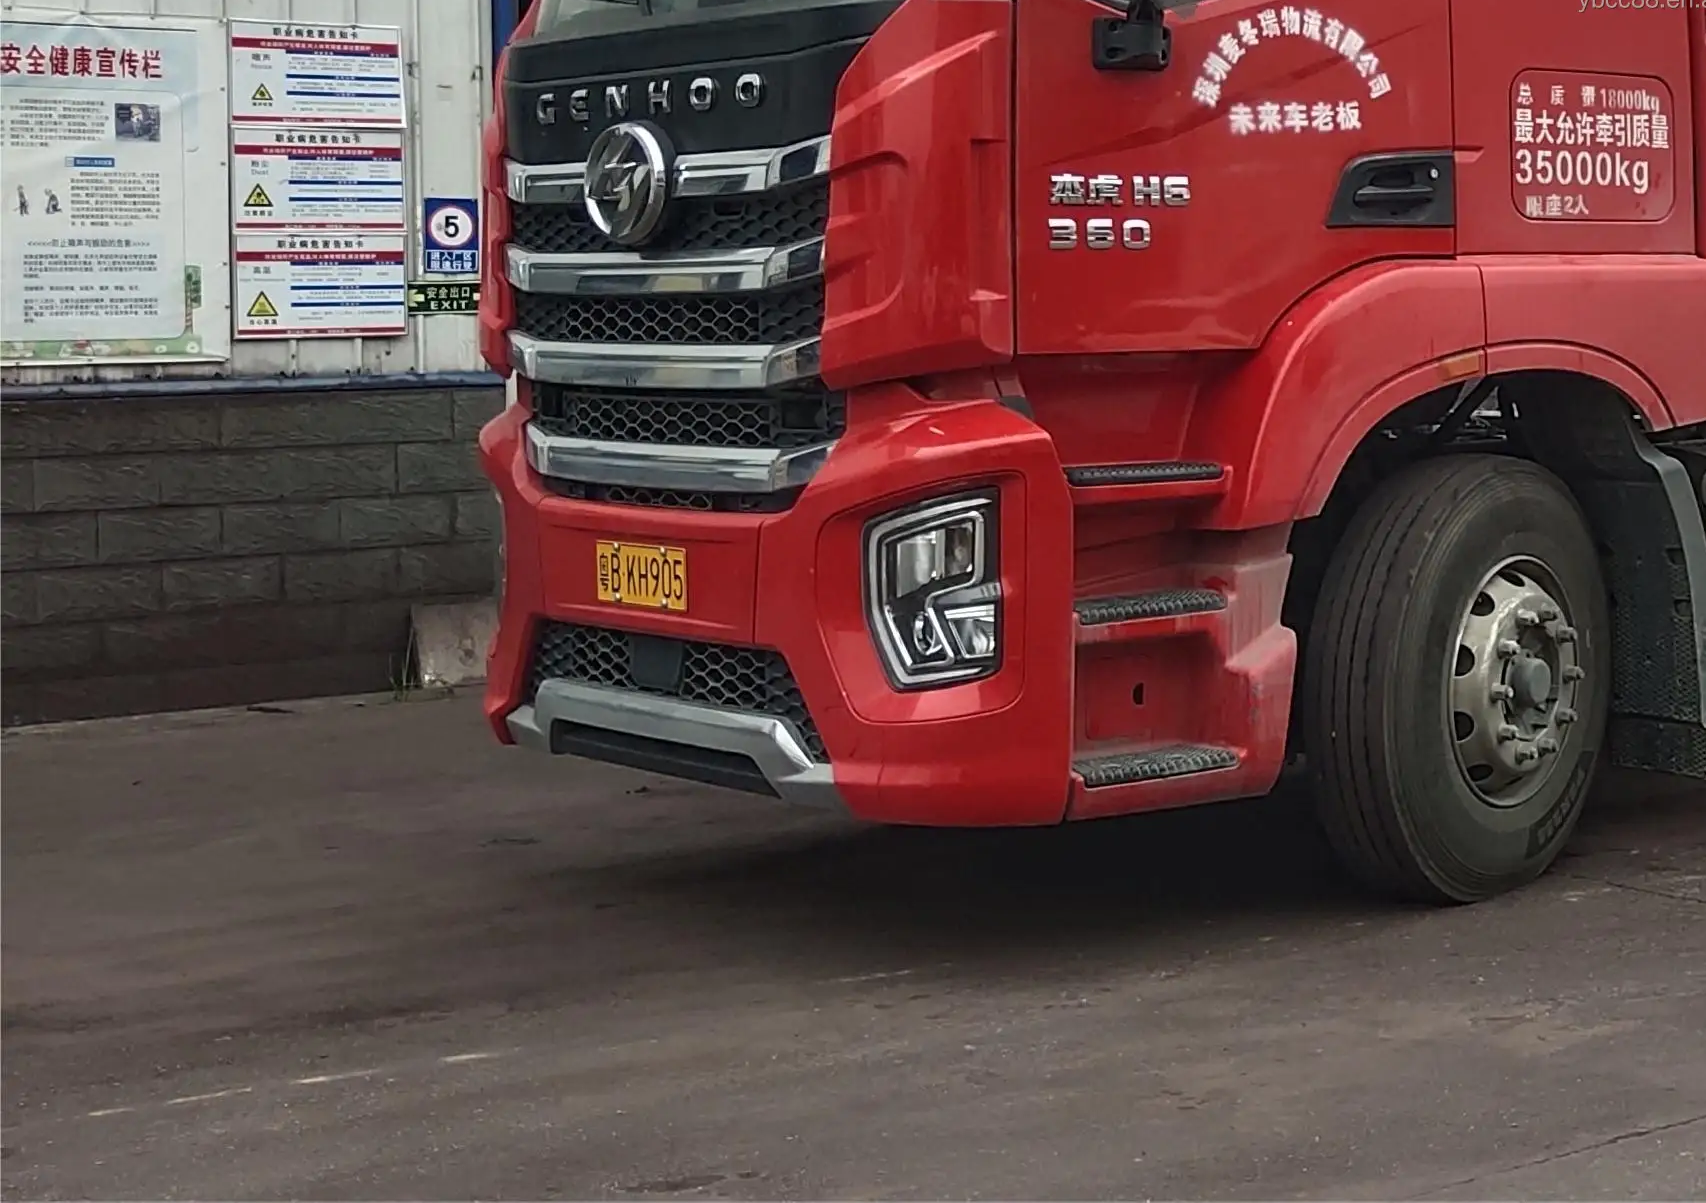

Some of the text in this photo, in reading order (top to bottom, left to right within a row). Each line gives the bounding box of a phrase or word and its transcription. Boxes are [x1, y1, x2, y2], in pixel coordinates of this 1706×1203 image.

[273, 27, 358, 40] 职业病危害告知卡
[0, 43, 163, 79] 安全健康宣传栏
[536, 73, 766, 126] GENHOO
[1600, 88, 1660, 114] 18000kg
[1229, 100, 1362, 136] 未来车老板
[1514, 108, 1669, 149] 最大允许牵引质量
[275, 134, 361, 144] 职业病危害告知卡
[1515, 149, 1649, 194] 35000kg
[1132, 175, 1191, 206] H6
[444, 215, 460, 238] 5
[1048, 218, 1151, 249] 360
[277, 239, 364, 249] 职业病危害告知卡
[427, 286, 470, 299] 安全出口
[430, 301, 468, 310] EXIT
